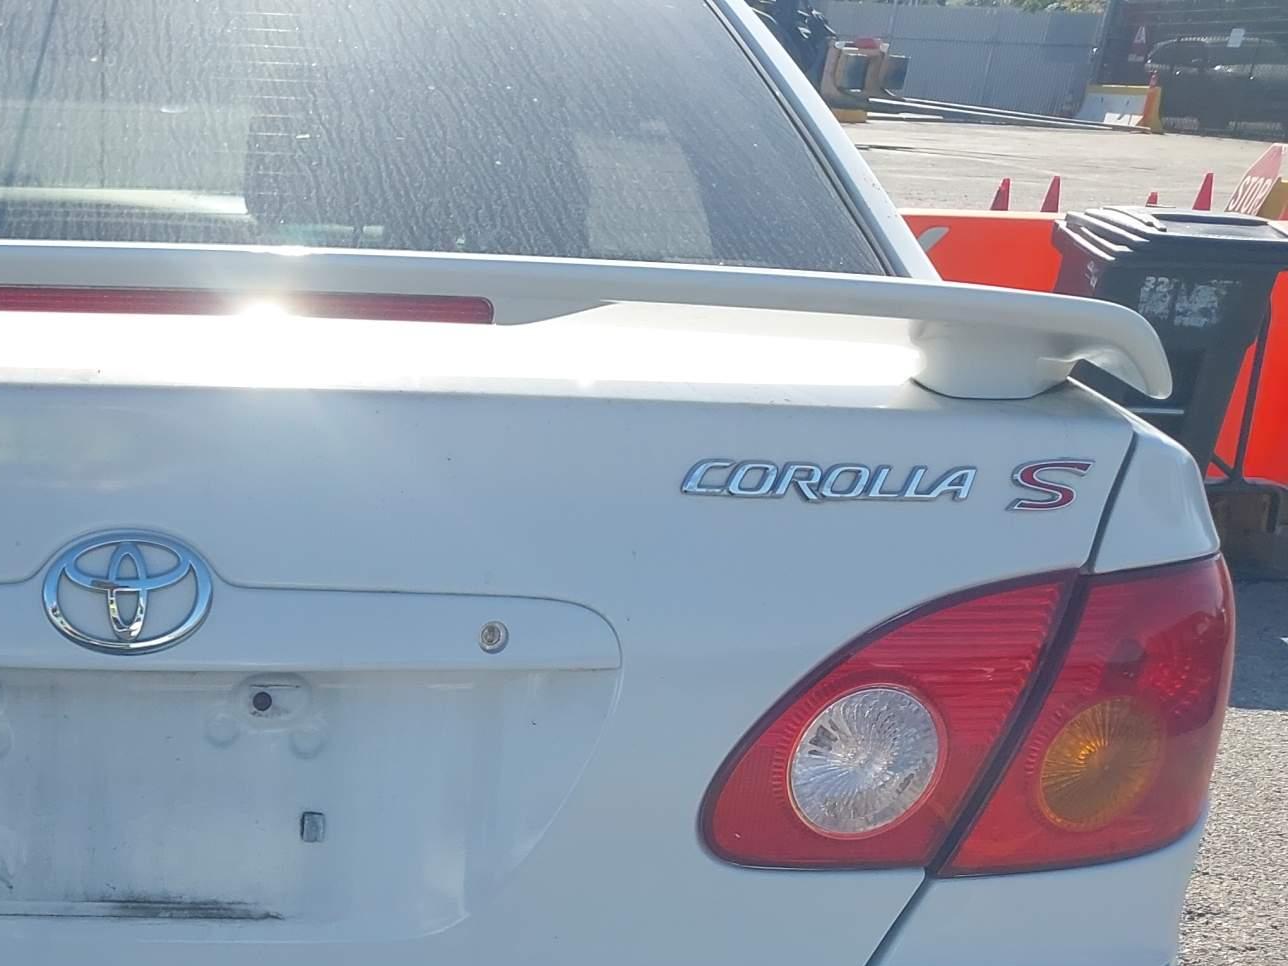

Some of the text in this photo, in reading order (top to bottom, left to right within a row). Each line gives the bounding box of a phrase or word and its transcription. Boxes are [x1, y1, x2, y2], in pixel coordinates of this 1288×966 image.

[1227, 175, 1273, 215] STOP
[680, 457, 1096, 513] COROLLA S
